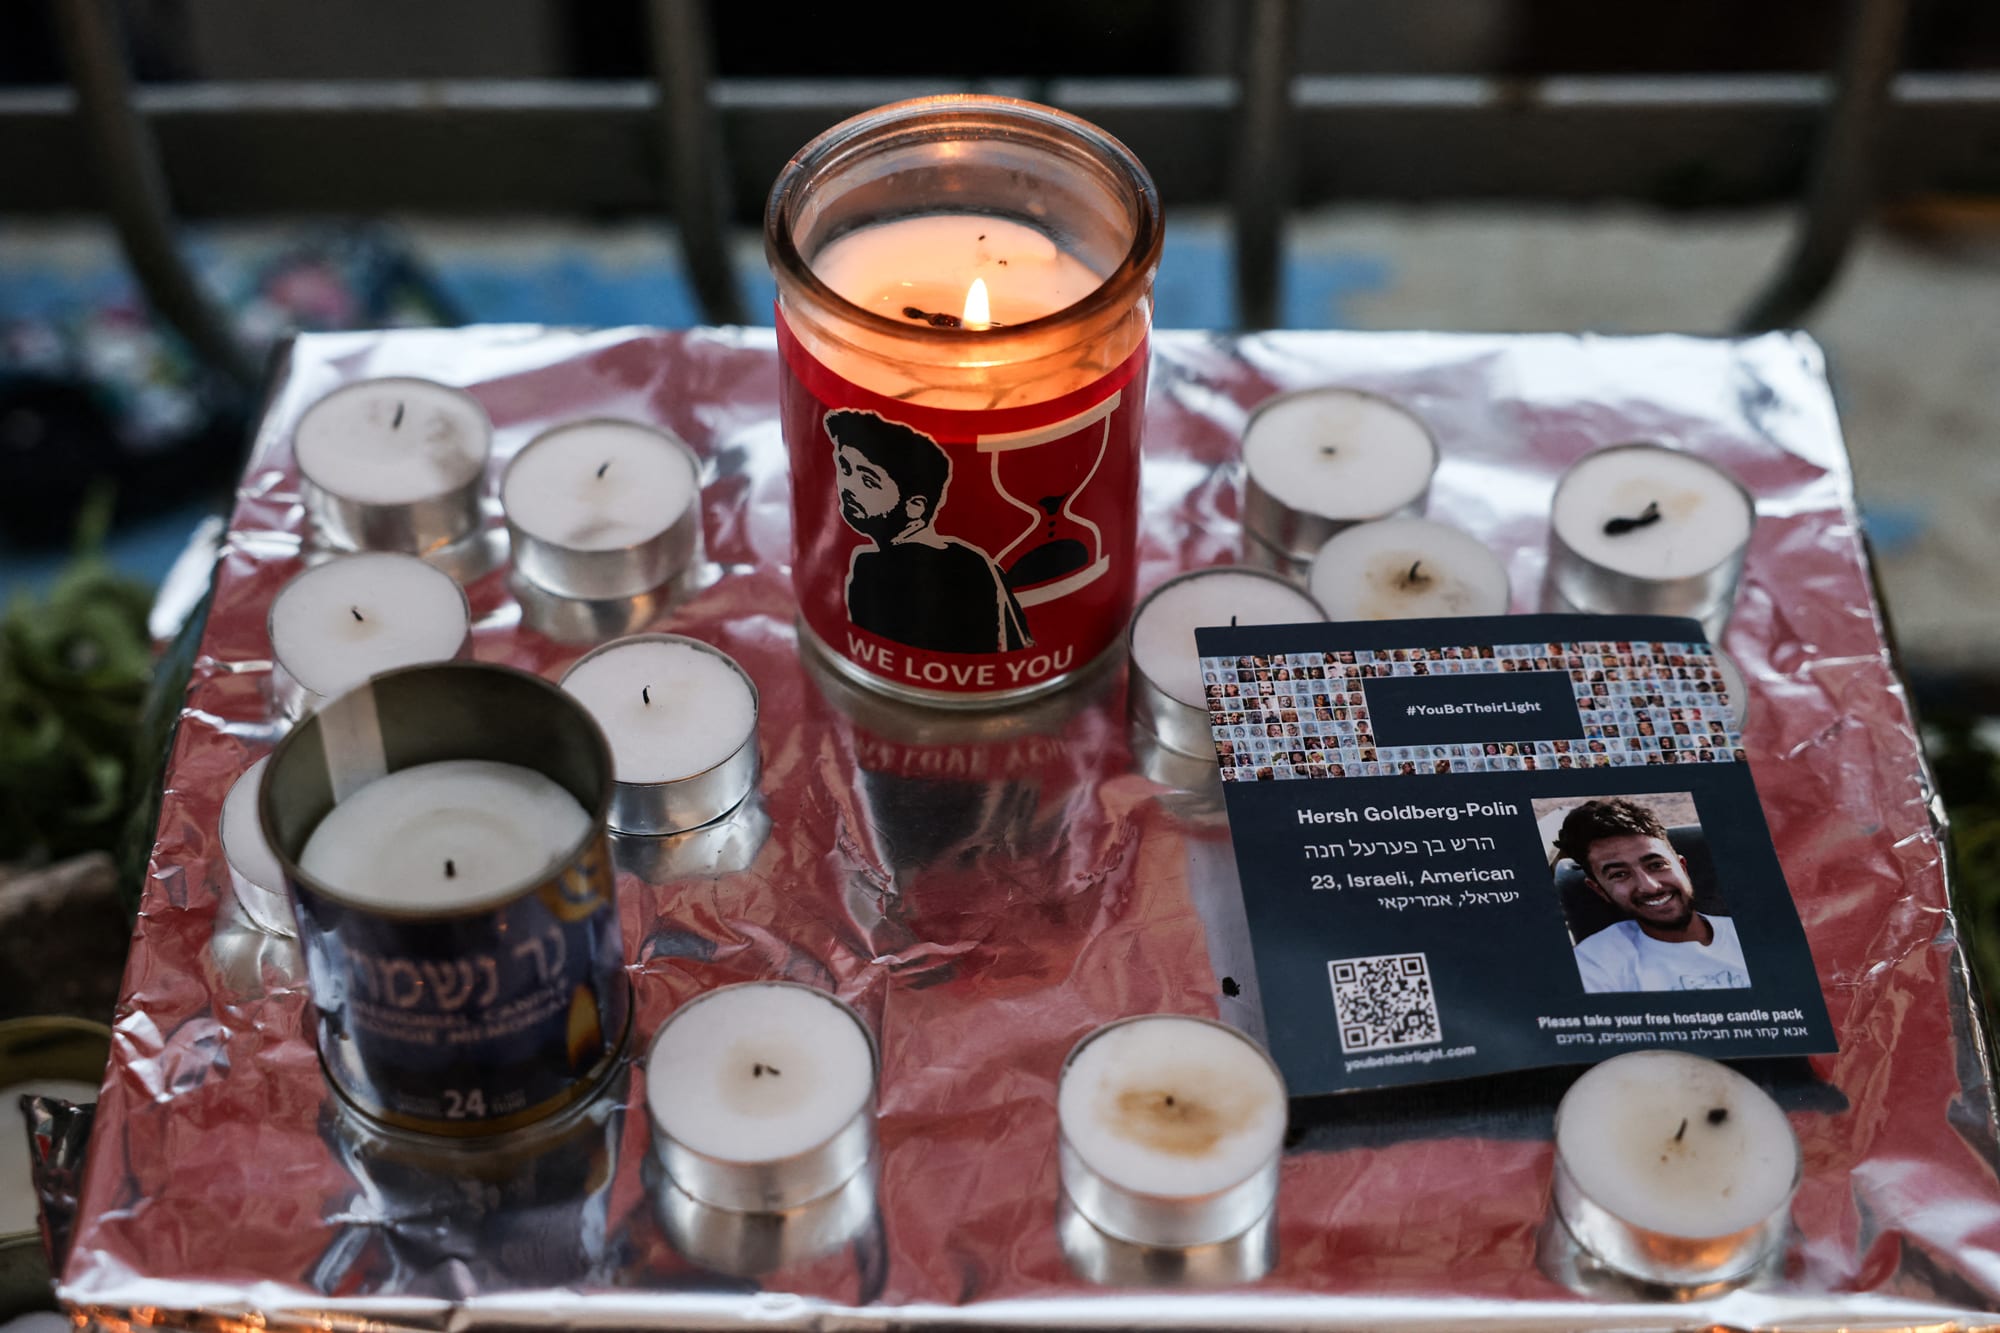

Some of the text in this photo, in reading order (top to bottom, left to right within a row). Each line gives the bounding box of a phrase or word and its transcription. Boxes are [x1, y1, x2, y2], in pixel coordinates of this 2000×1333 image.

[847, 632, 1074, 686] WE LOVE YOU
[1406, 701, 1542, 716] #YouBeTheirLight
[1297, 801, 1518, 824] Hersh Goldberg-Polin
[1304, 836, 1495, 859] הרש בן פערעל חנה
[1310, 867, 1515, 891] 23, Israeli, American
[1378, 890, 1519, 911] ישראלי, אמריקאי
[514, 925, 567, 981] נר
[1538, 1008, 1804, 1028] Please take your free hostage candle pack
[1690, 1027, 1730, 1040] חבילת
[1733, 1028, 1753, 1039] את
[1755, 1027, 1779, 1039] קחו
[1783, 1026, 1808, 1037] אנא
[1344, 1046, 1476, 1073] youbetheirlight.com
[444, 1089, 486, 1118] 24
